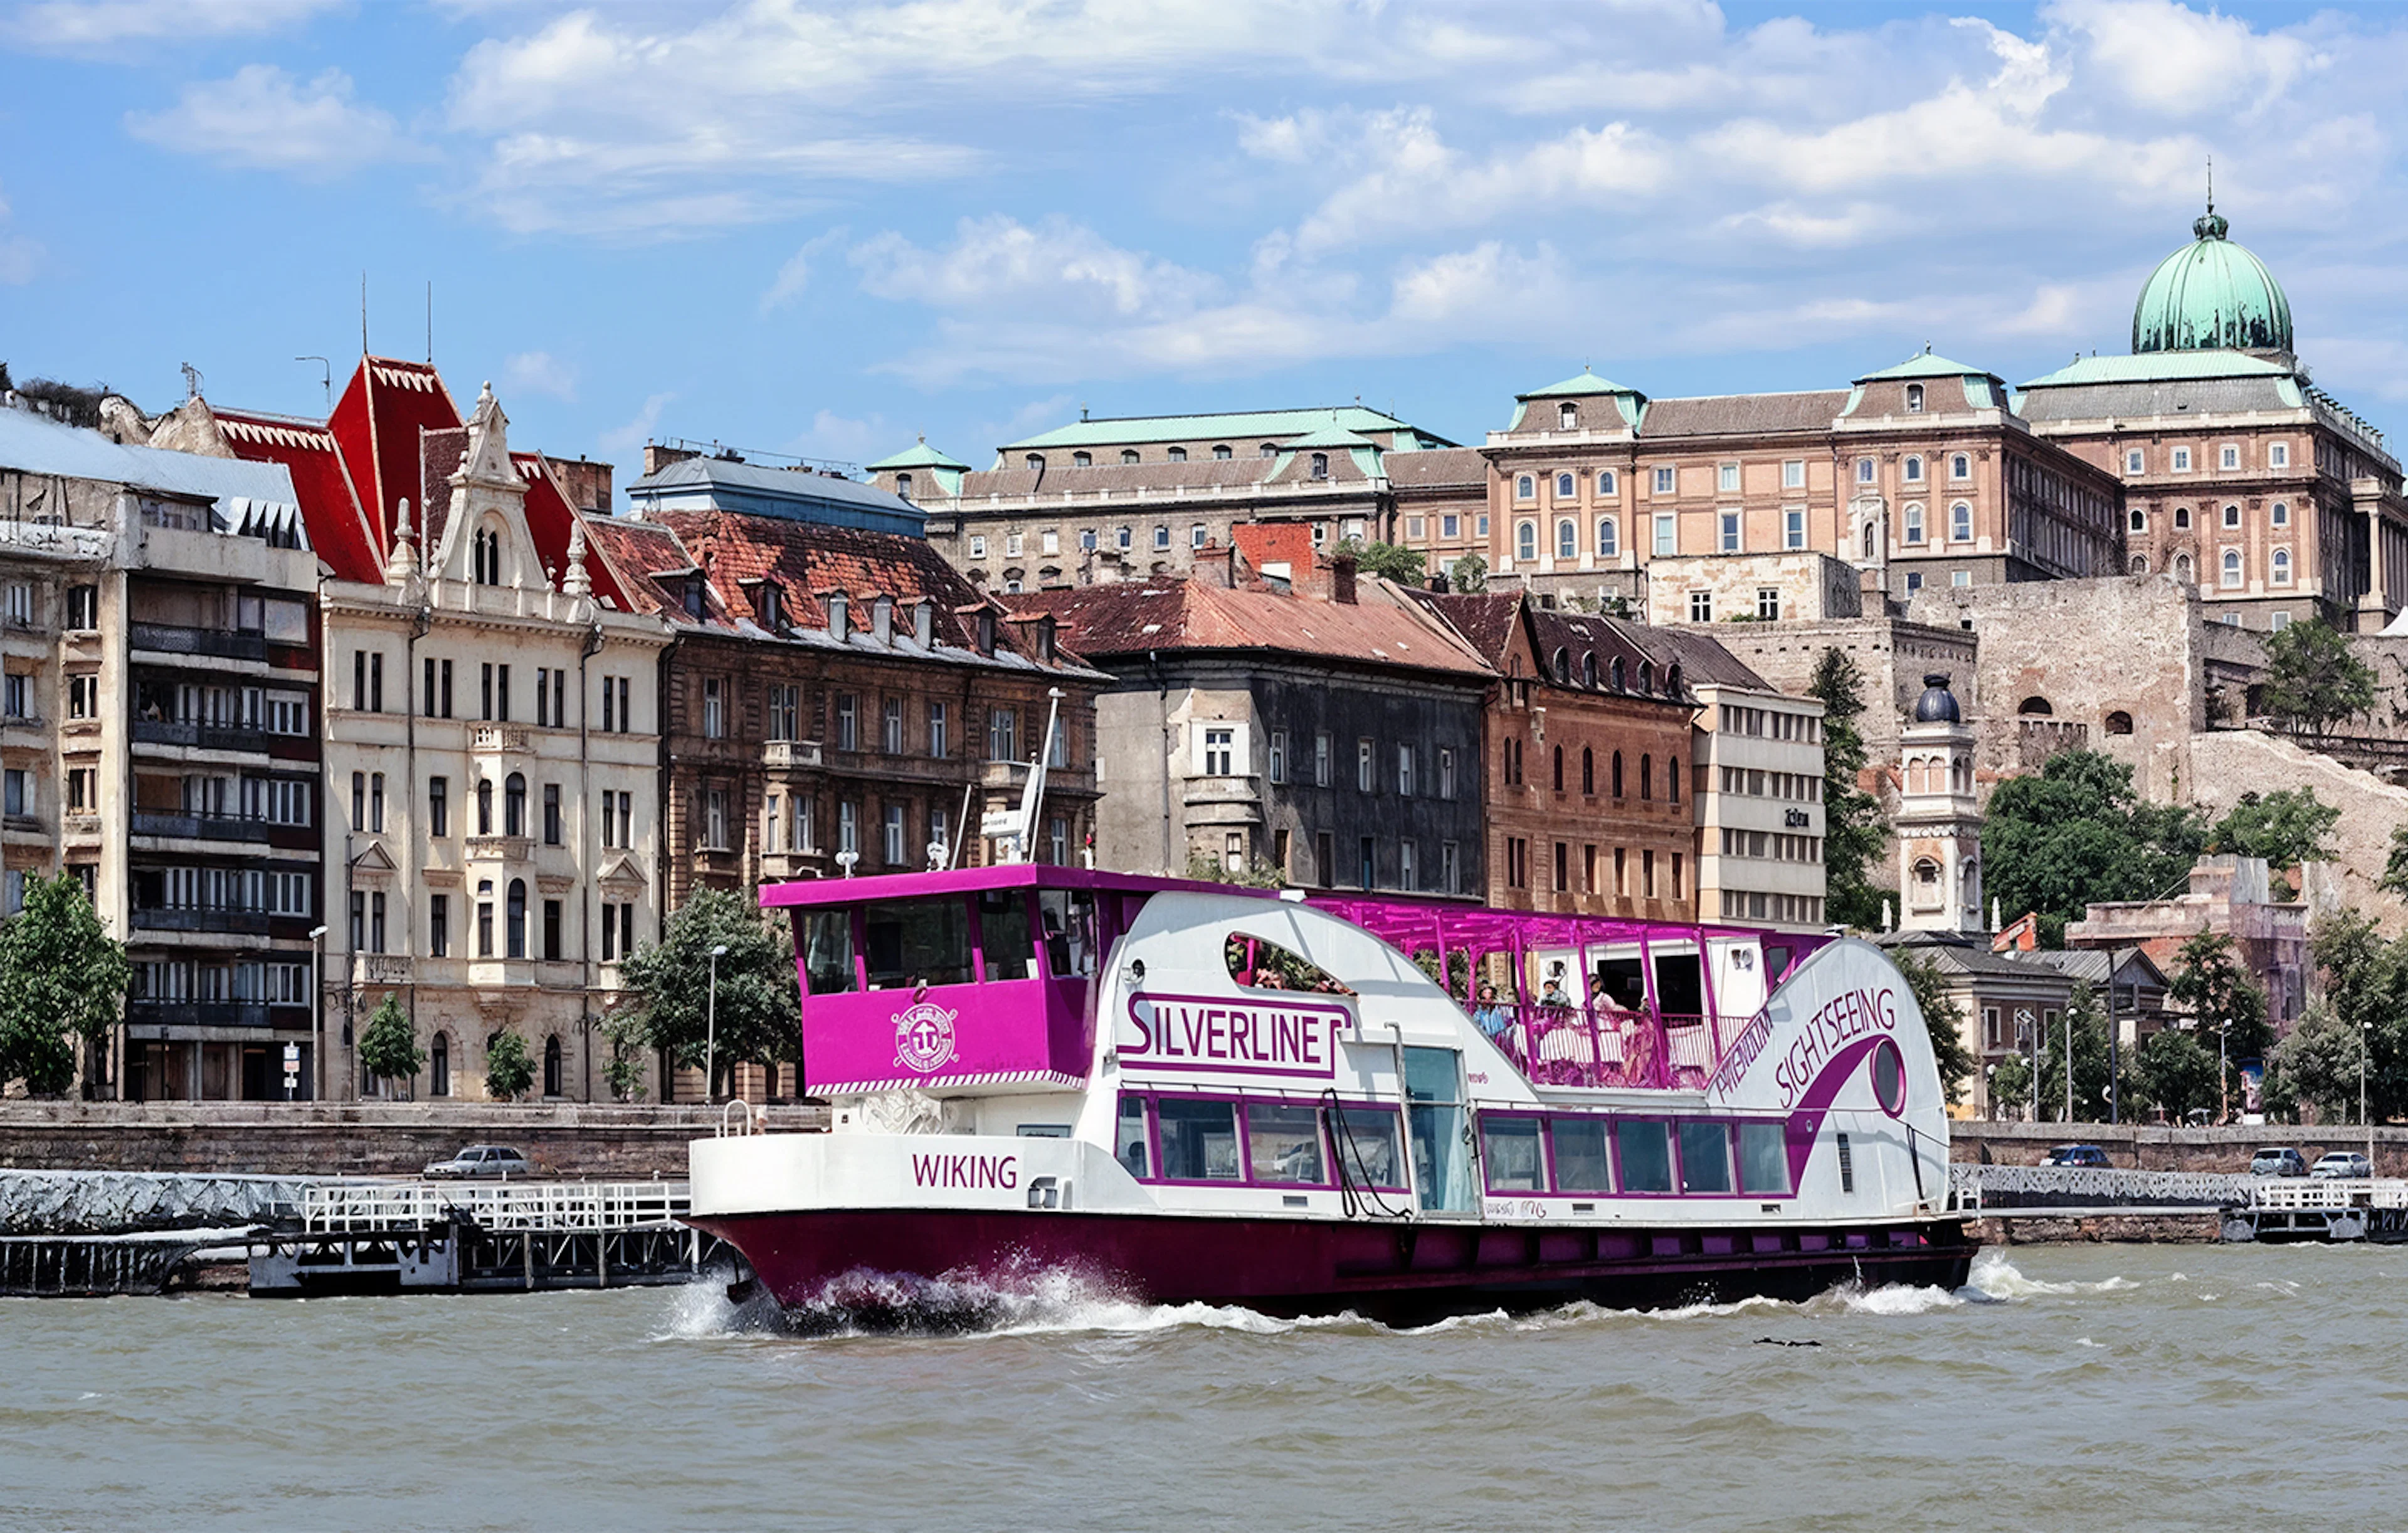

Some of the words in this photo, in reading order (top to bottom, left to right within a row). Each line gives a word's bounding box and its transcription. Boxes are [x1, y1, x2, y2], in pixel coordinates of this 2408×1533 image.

[1116, 992, 1321, 1064] SILVERLINE
[1775, 988, 1895, 1109] SIGHTSEEING
[912, 1154, 1017, 1190] WIKING
